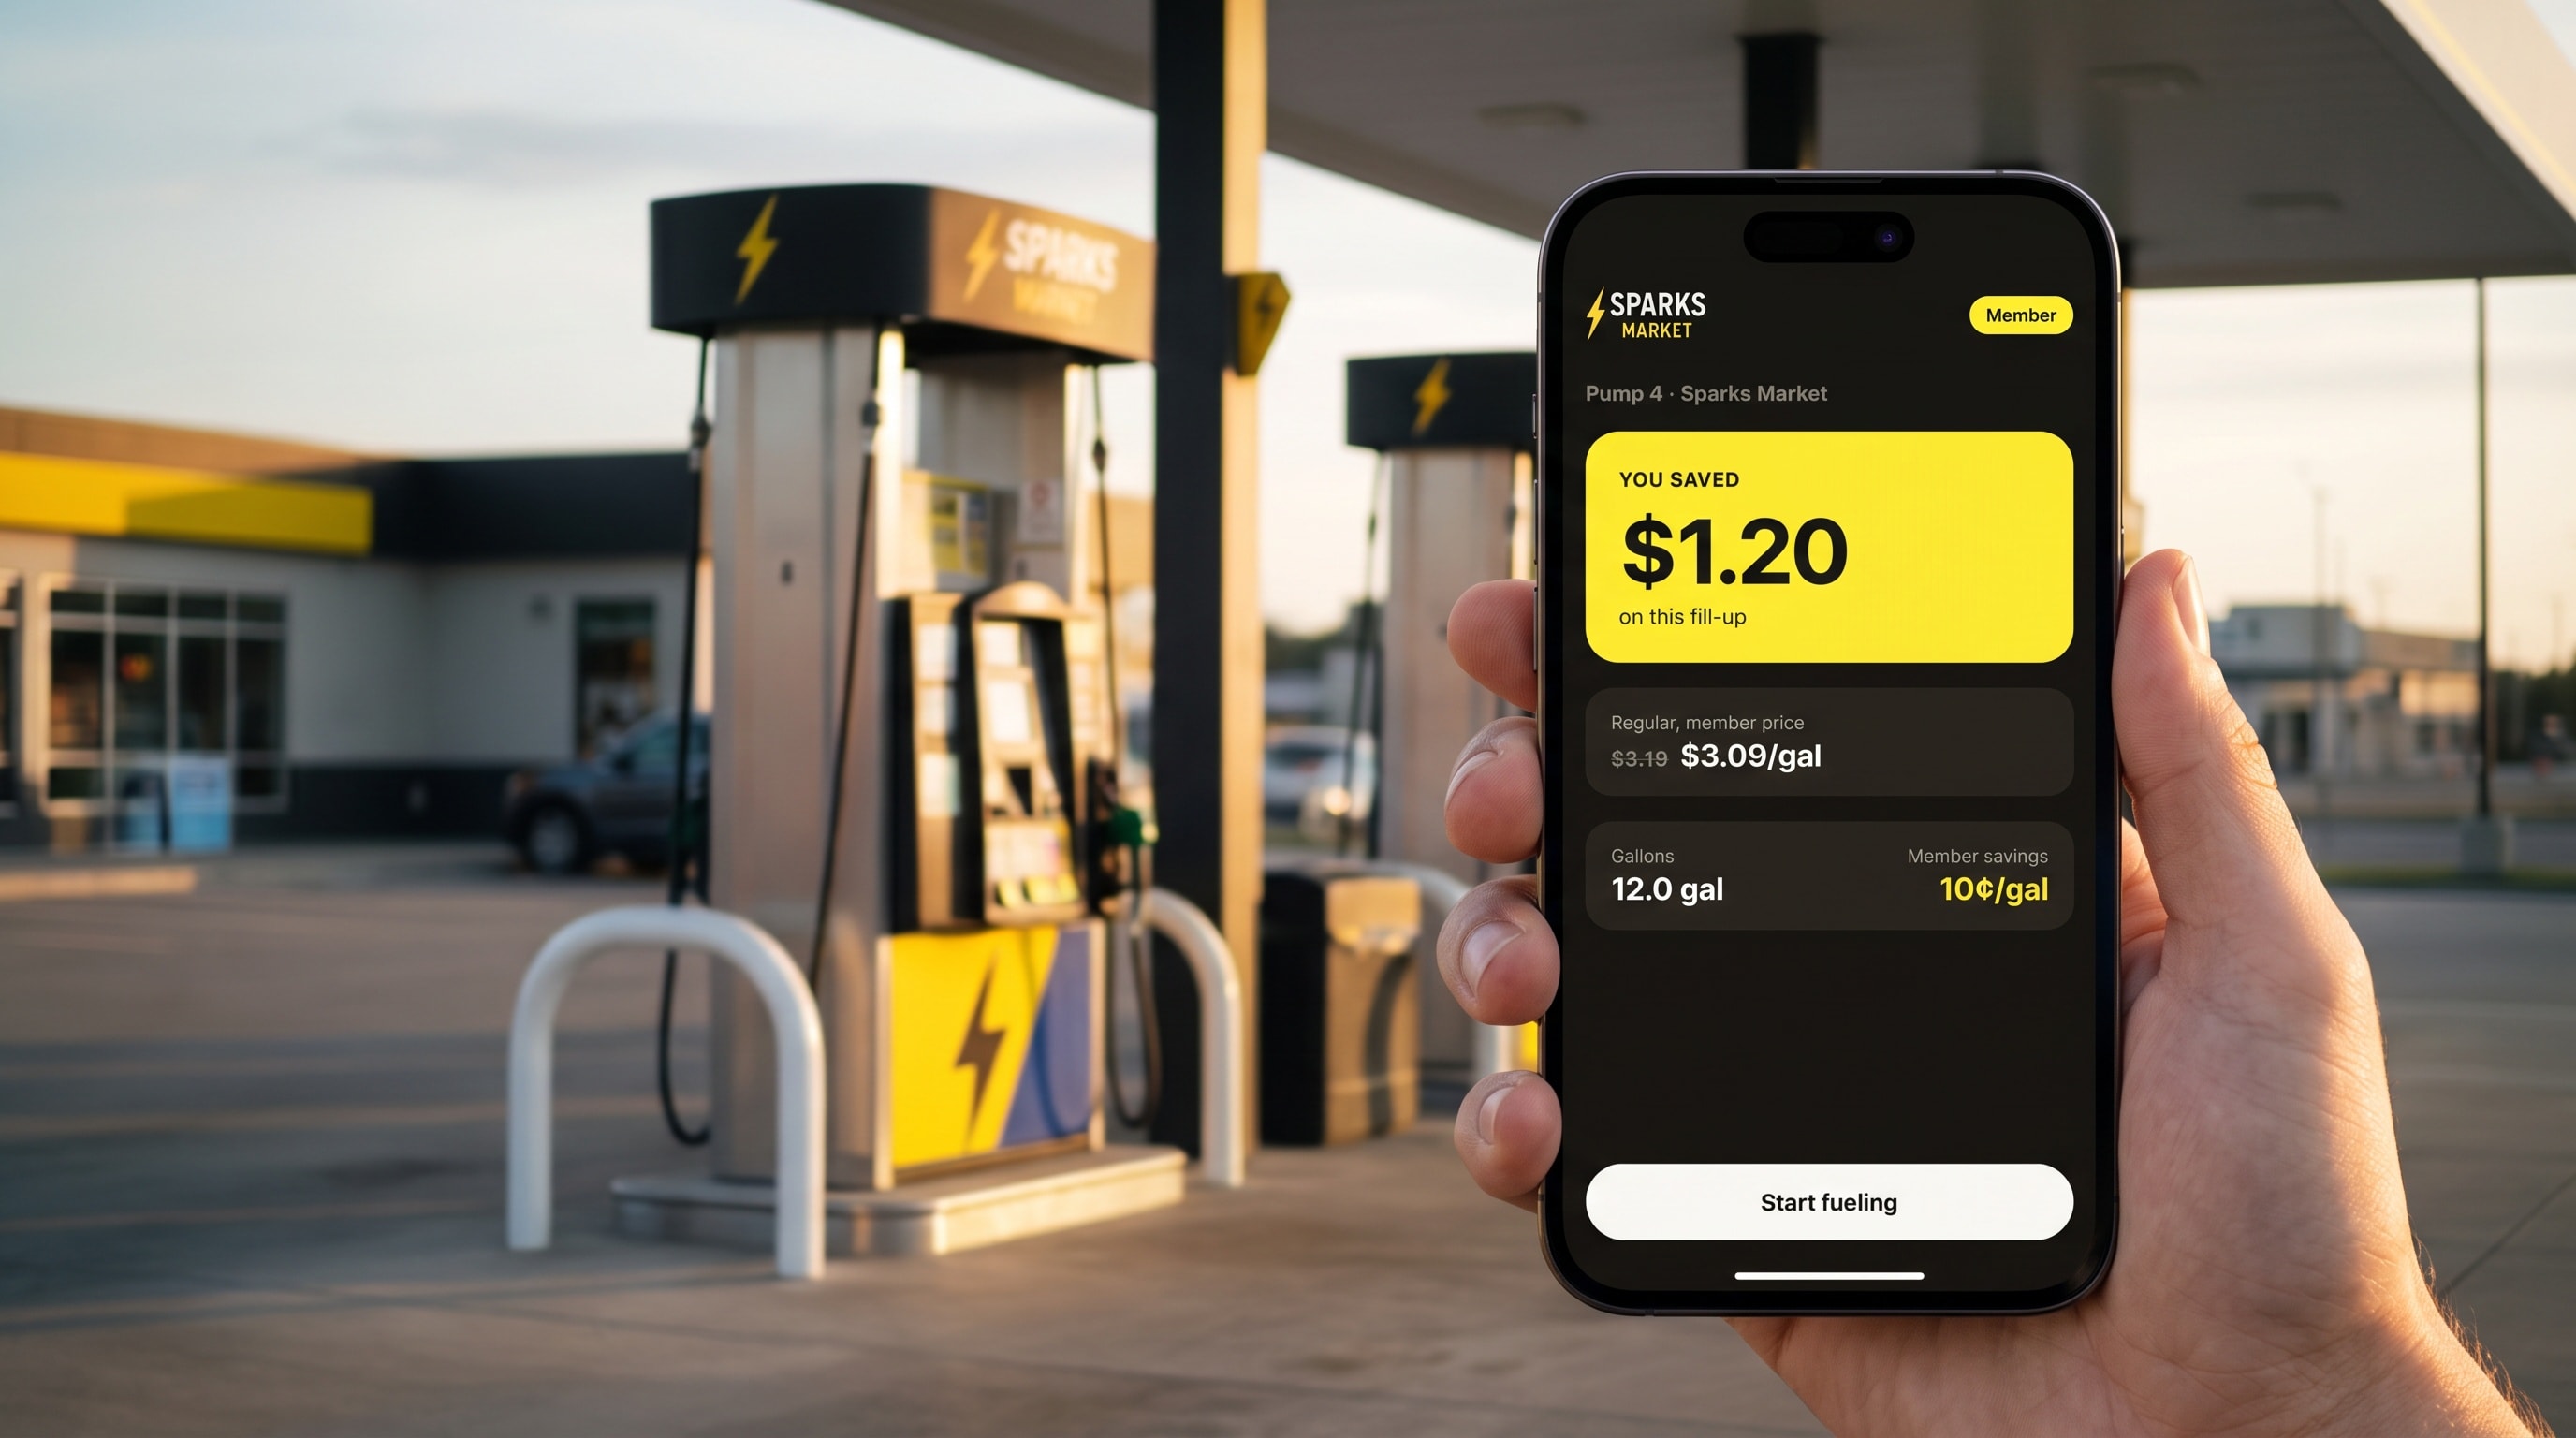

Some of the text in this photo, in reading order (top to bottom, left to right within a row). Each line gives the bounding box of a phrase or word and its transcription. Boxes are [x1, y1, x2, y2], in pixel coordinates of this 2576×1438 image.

[1610, 291, 1706, 317] SPARKS
[1986, 307, 2057, 323] Member
[1622, 322, 1692, 339] MARKET
[1586, 385, 1645, 406] Pump
[1649, 385, 1663, 402] 4
[1680, 384, 1751, 406] Sparks
[1757, 385, 1828, 402] Market
[1618, 471, 1740, 488] YOU SAVED
[1623, 512, 1848, 591] $1.20
[1618, 607, 1747, 629] on this fill-up
[1612, 714, 1805, 734] Regular, member price
[1612, 741, 1822, 773] $3.19 $3.09/gal
[1611, 848, 1675, 864] Gallons
[1908, 848, 2049, 868] Member savings
[1612, 876, 1723, 907] 12.0 gal
[1940, 876, 2048, 907] 10¢/gal
[1761, 1192, 1897, 1216] Start fueling
